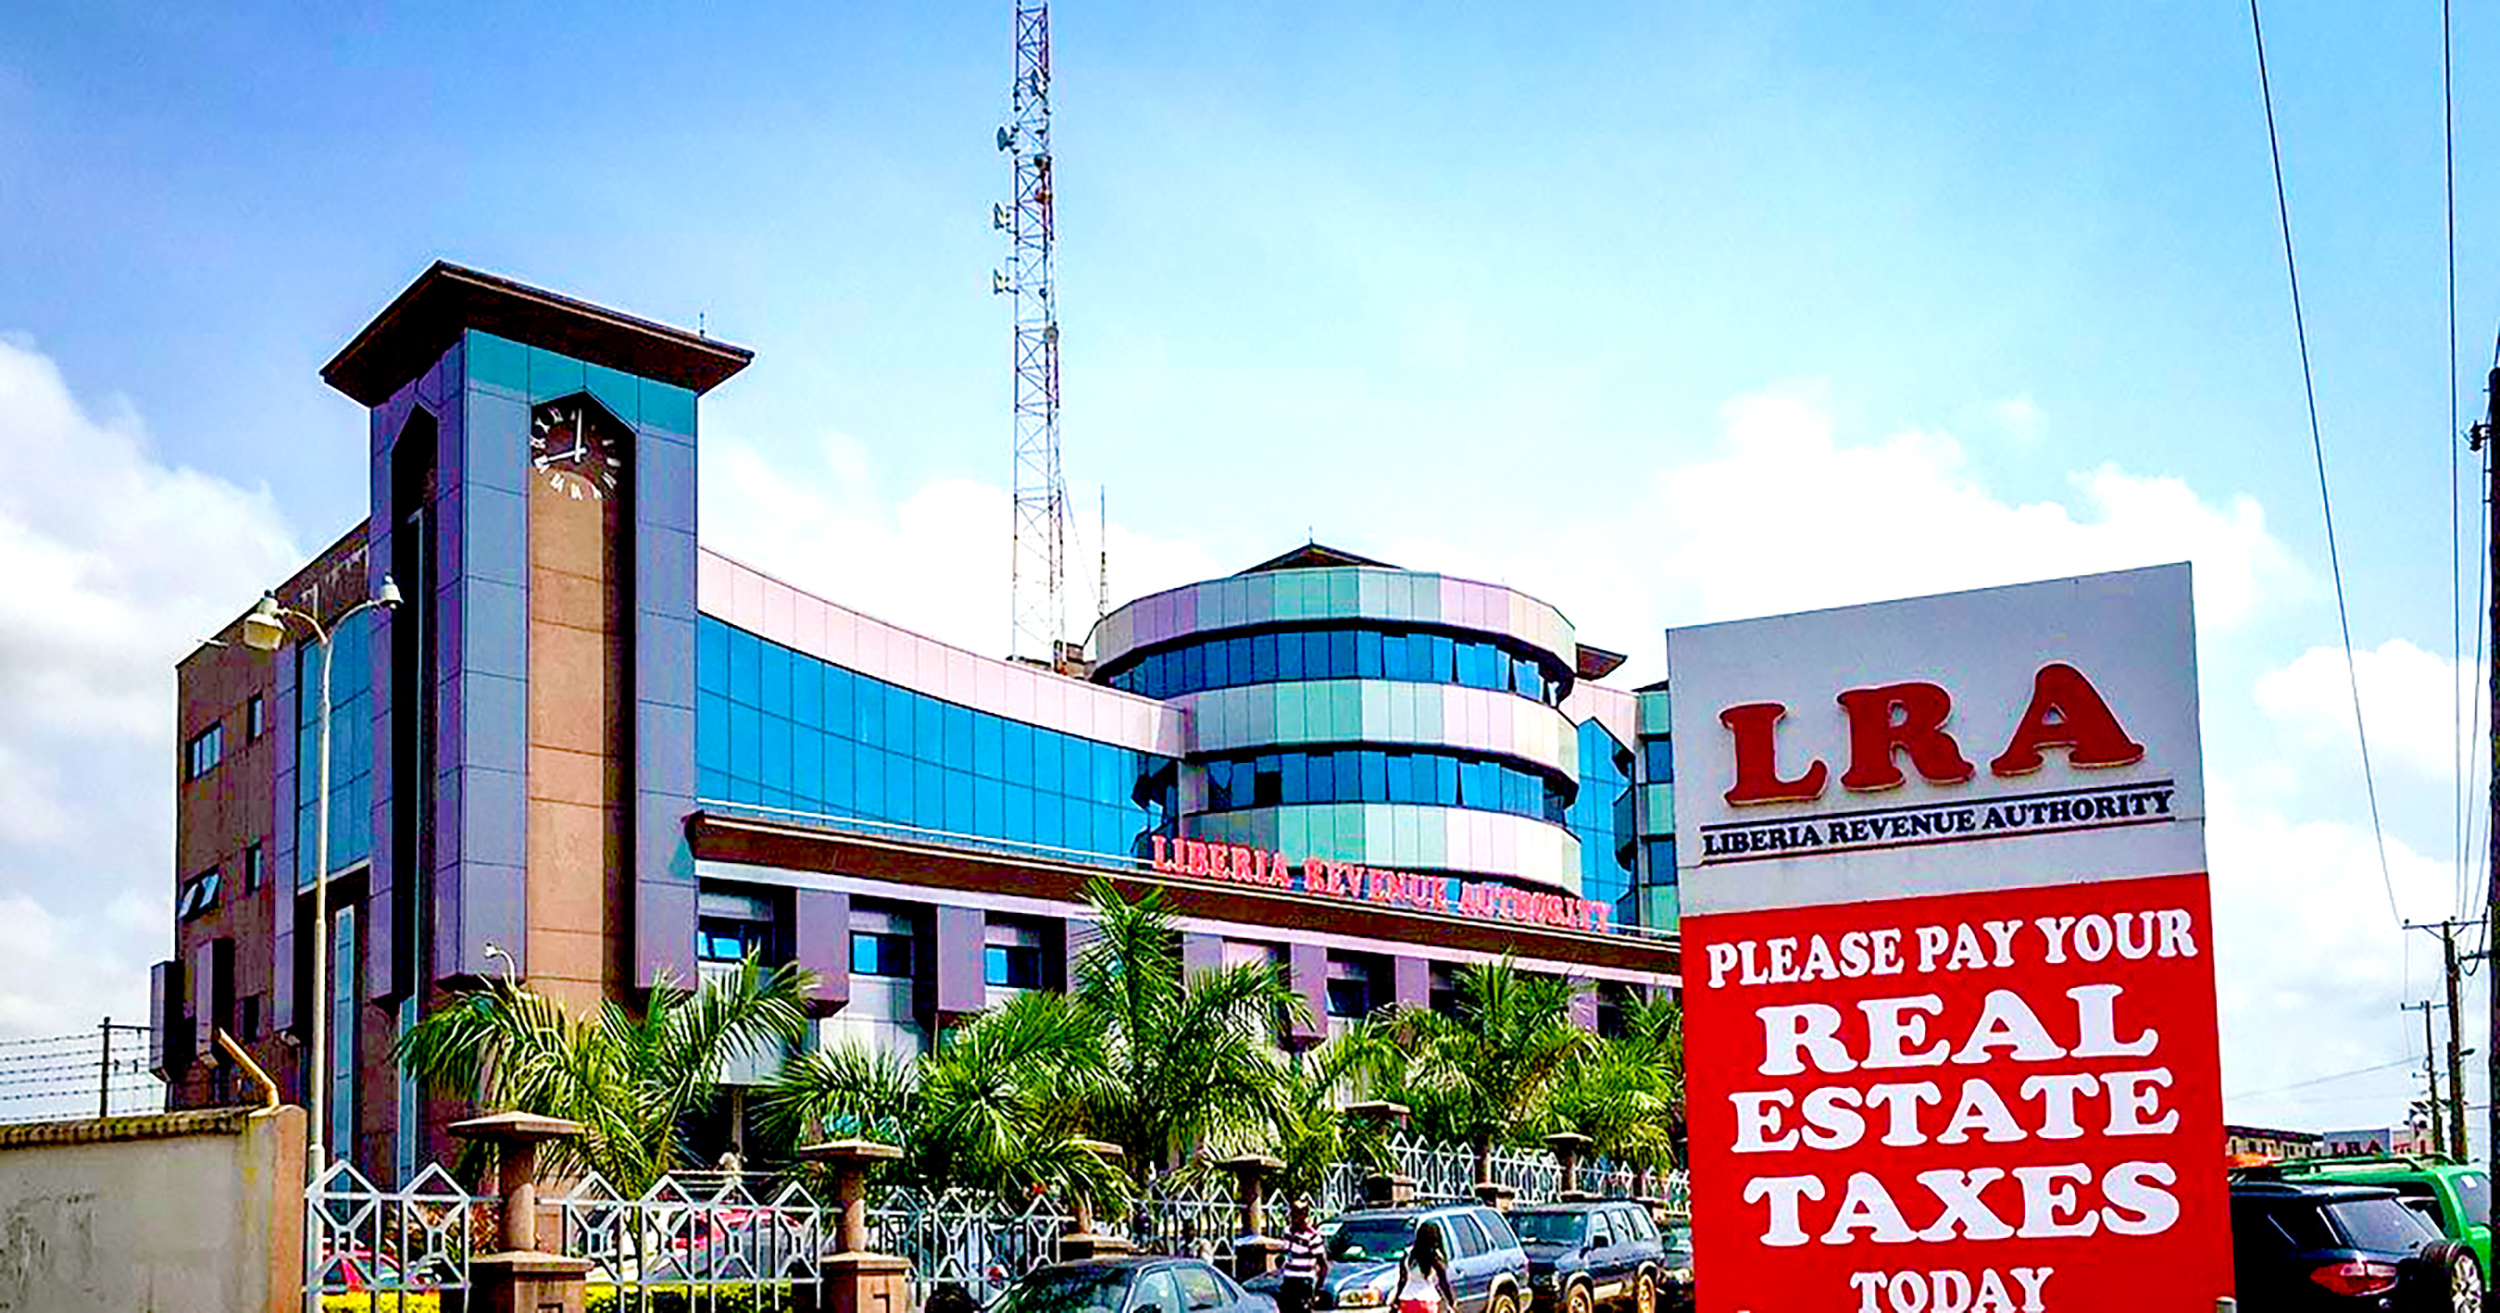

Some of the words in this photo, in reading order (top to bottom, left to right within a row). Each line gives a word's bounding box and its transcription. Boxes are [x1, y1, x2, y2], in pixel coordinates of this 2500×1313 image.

[1719, 663, 2145, 807] LRA
[1702, 823, 1823, 856] LIBERIA
[1828, 809, 1976, 844] REVENUE
[1981, 789, 2175, 830] AUTHORITY
[1151, 834, 1293, 888] LIBERIA
[1302, 857, 1448, 911] REVENUE
[1706, 928, 1905, 989] PLEASE
[1915, 920, 2024, 973] PAY
[2034, 908, 2199, 964] YOUR
[1755, 983, 2159, 1076] REAL
[1728, 1067, 2180, 1154] ESTATE
[1743, 1161, 2180, 1246] TAXES
[1849, 1267, 2054, 1313] TODAY
